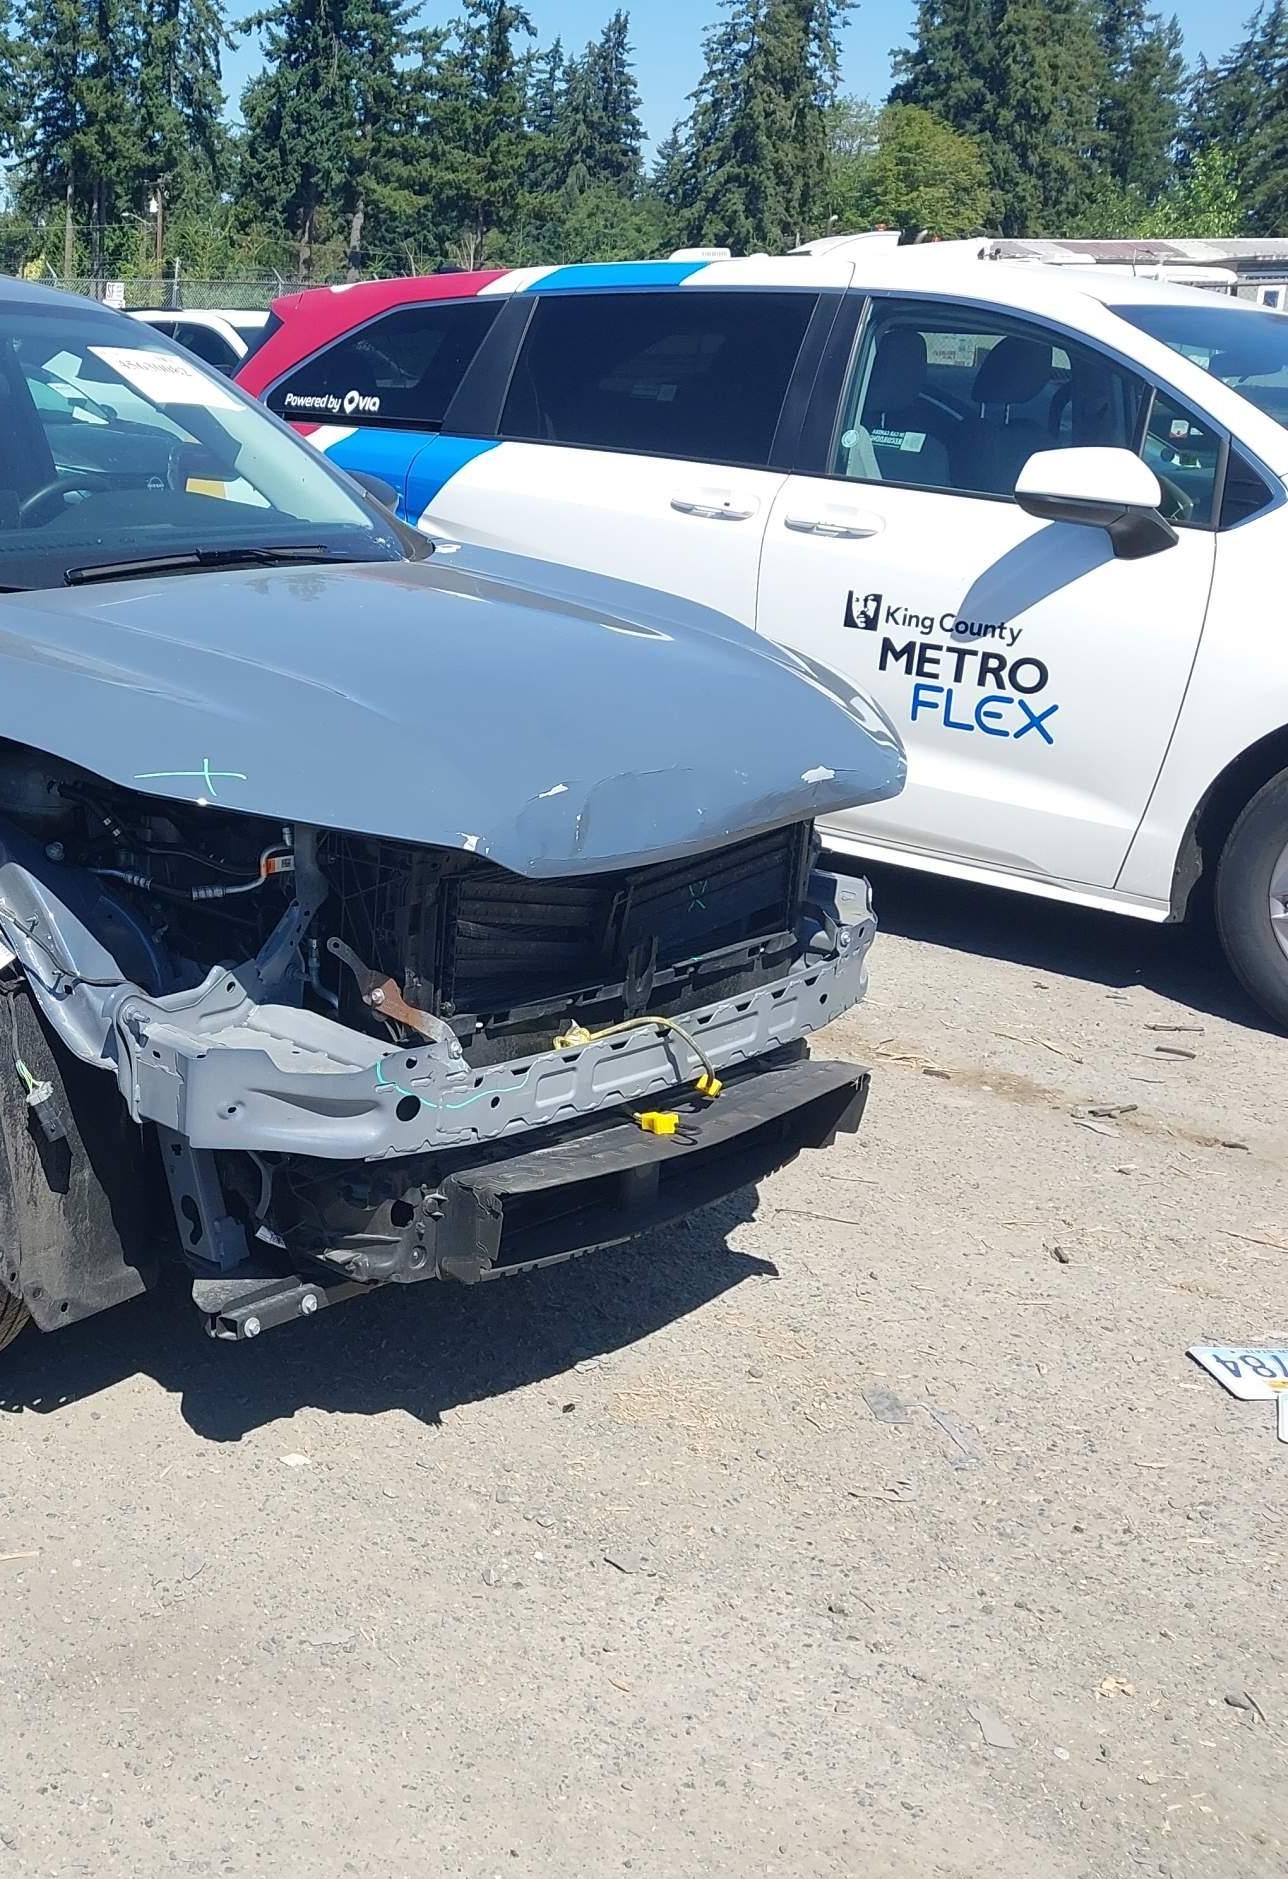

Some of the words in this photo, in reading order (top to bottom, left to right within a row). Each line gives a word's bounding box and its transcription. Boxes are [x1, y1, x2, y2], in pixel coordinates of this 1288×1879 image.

[284, 393, 329, 407] Powered
[328, 394, 342, 412] by
[884, 605, 935, 635] King
[939, 613, 1023, 647] County
[878, 636, 1049, 694] METRO
[911, 682, 1059, 745] FLEX
